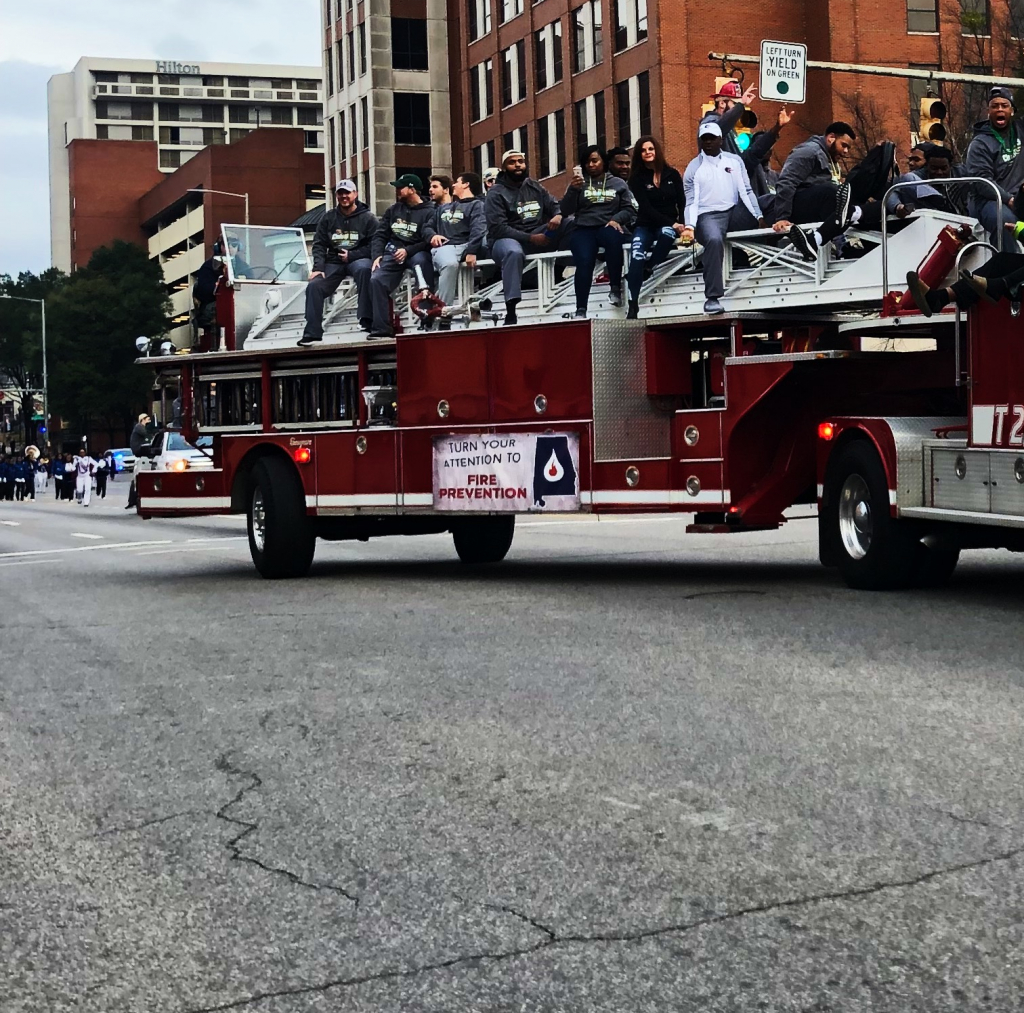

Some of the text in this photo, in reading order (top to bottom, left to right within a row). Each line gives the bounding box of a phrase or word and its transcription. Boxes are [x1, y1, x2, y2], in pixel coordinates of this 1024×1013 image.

[766, 47, 802, 58] LEFT TURN
[155, 60, 201, 74] Hilton
[768, 56, 798, 70] YIELD
[766, 68, 800, 80] ON GREEN
[449, 439, 516, 454] TURN YOUR
[443, 452, 521, 468] ATTENTION TO
[467, 474, 497, 485] FIRE
[439, 487, 527, 499] PREVENTION
